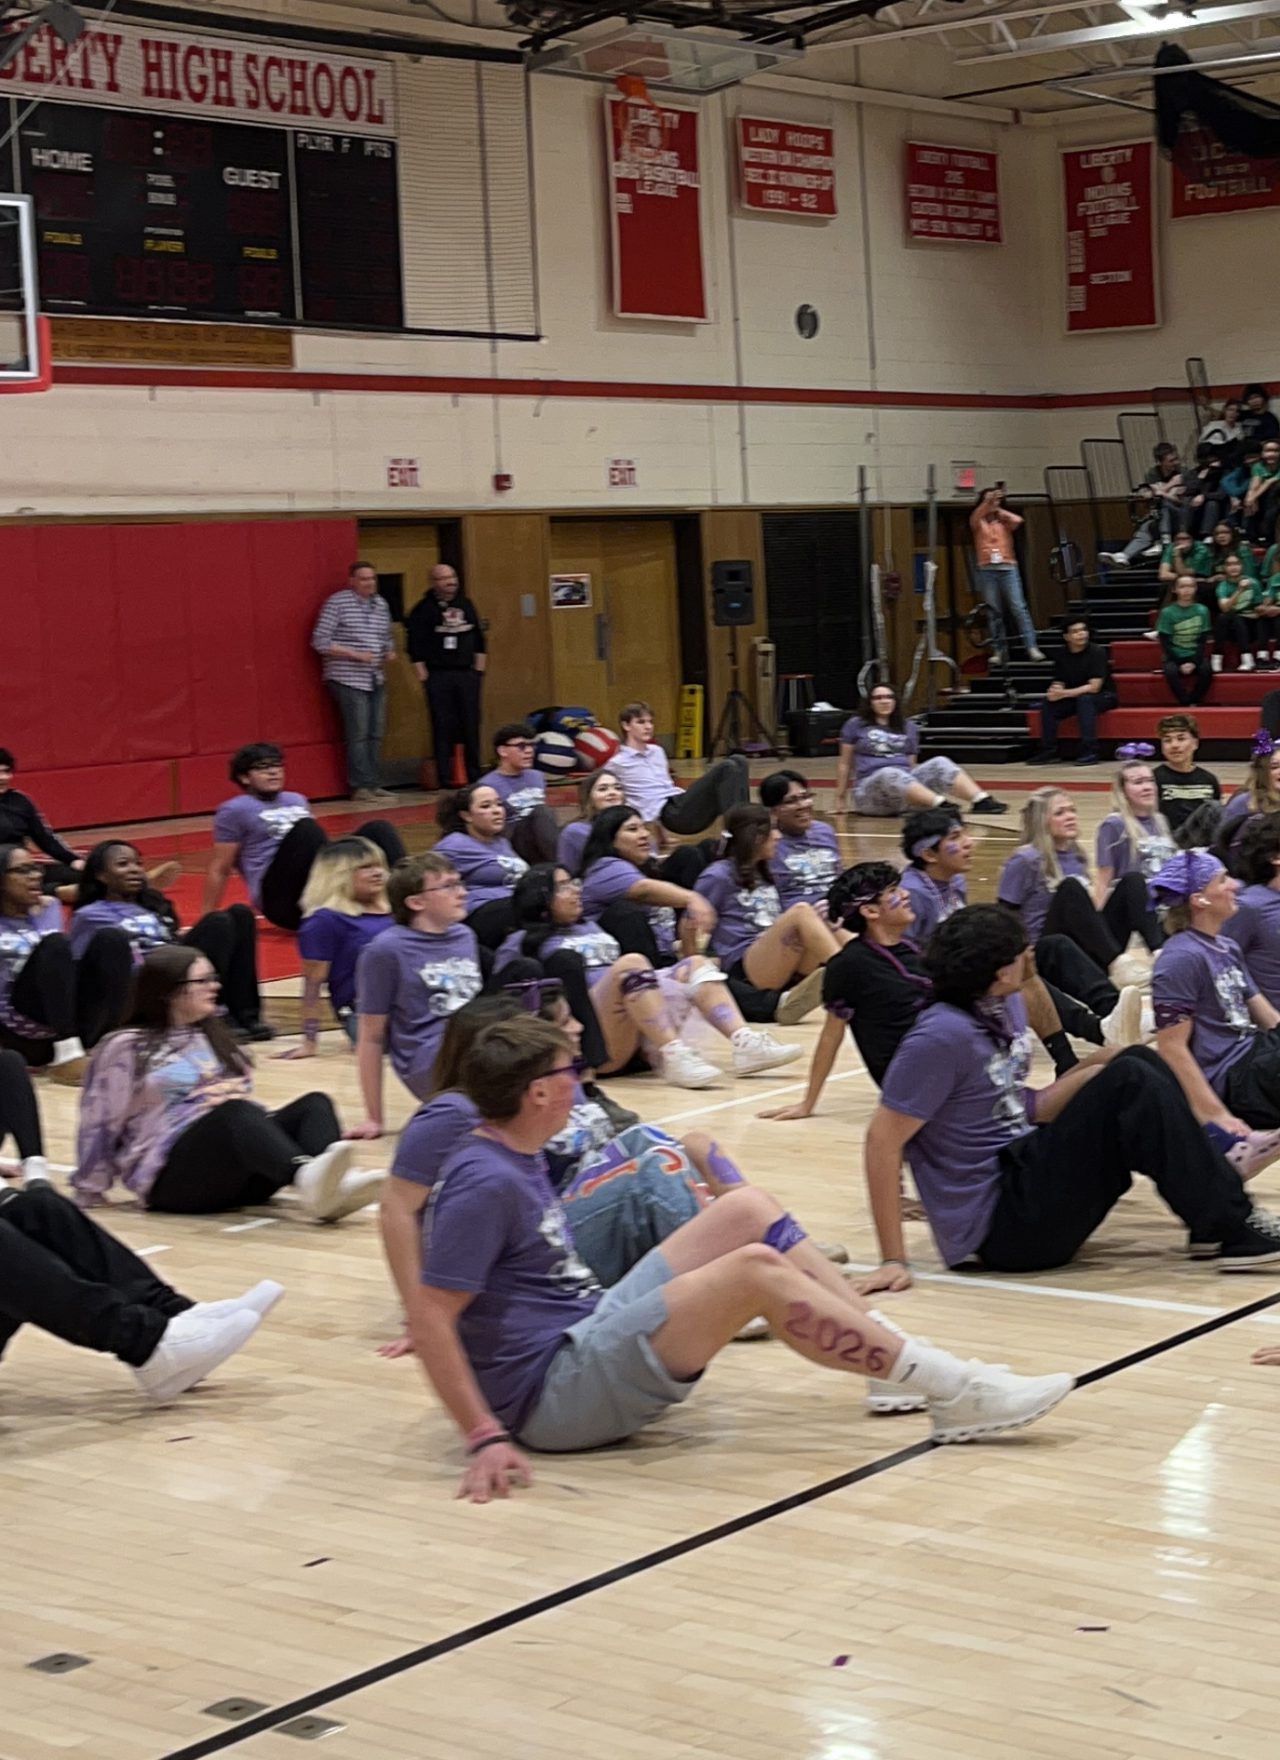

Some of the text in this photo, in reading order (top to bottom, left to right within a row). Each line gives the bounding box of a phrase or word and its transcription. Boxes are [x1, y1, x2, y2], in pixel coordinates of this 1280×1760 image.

[139, 39, 236, 107] HIGH
[245, 53, 385, 124] SCHOOL
[31, 148, 94, 171] HOME
[222, 167, 282, 189] GUEST
[1184, 178, 1272, 201] FOOTBALL
[784, 1301, 889, 1372] 2026
